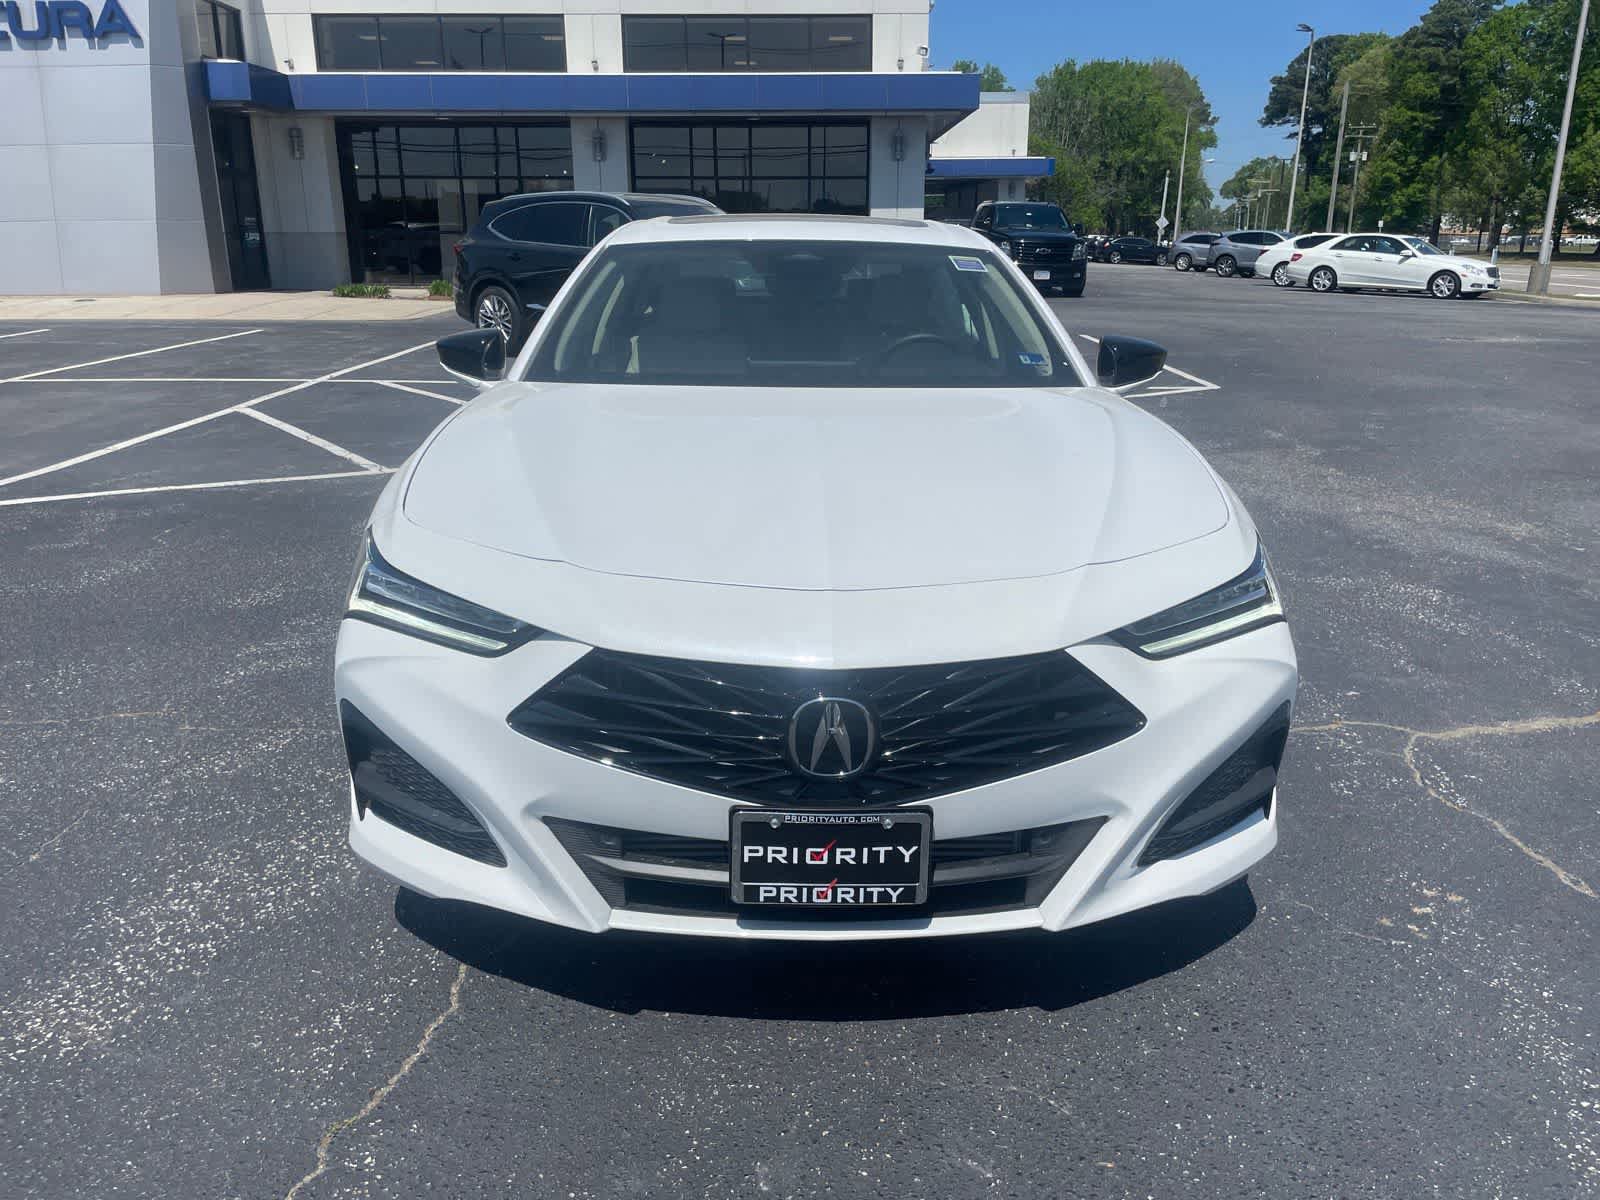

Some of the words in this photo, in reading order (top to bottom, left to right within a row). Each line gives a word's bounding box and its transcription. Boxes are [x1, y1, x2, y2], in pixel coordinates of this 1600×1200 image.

[0, 0, 142, 40] URA
[784, 815, 880, 823] PRIORITYAUTO.COM
[743, 846, 918, 864] PRIORITY
[759, 886, 904, 903] PRIORITY
